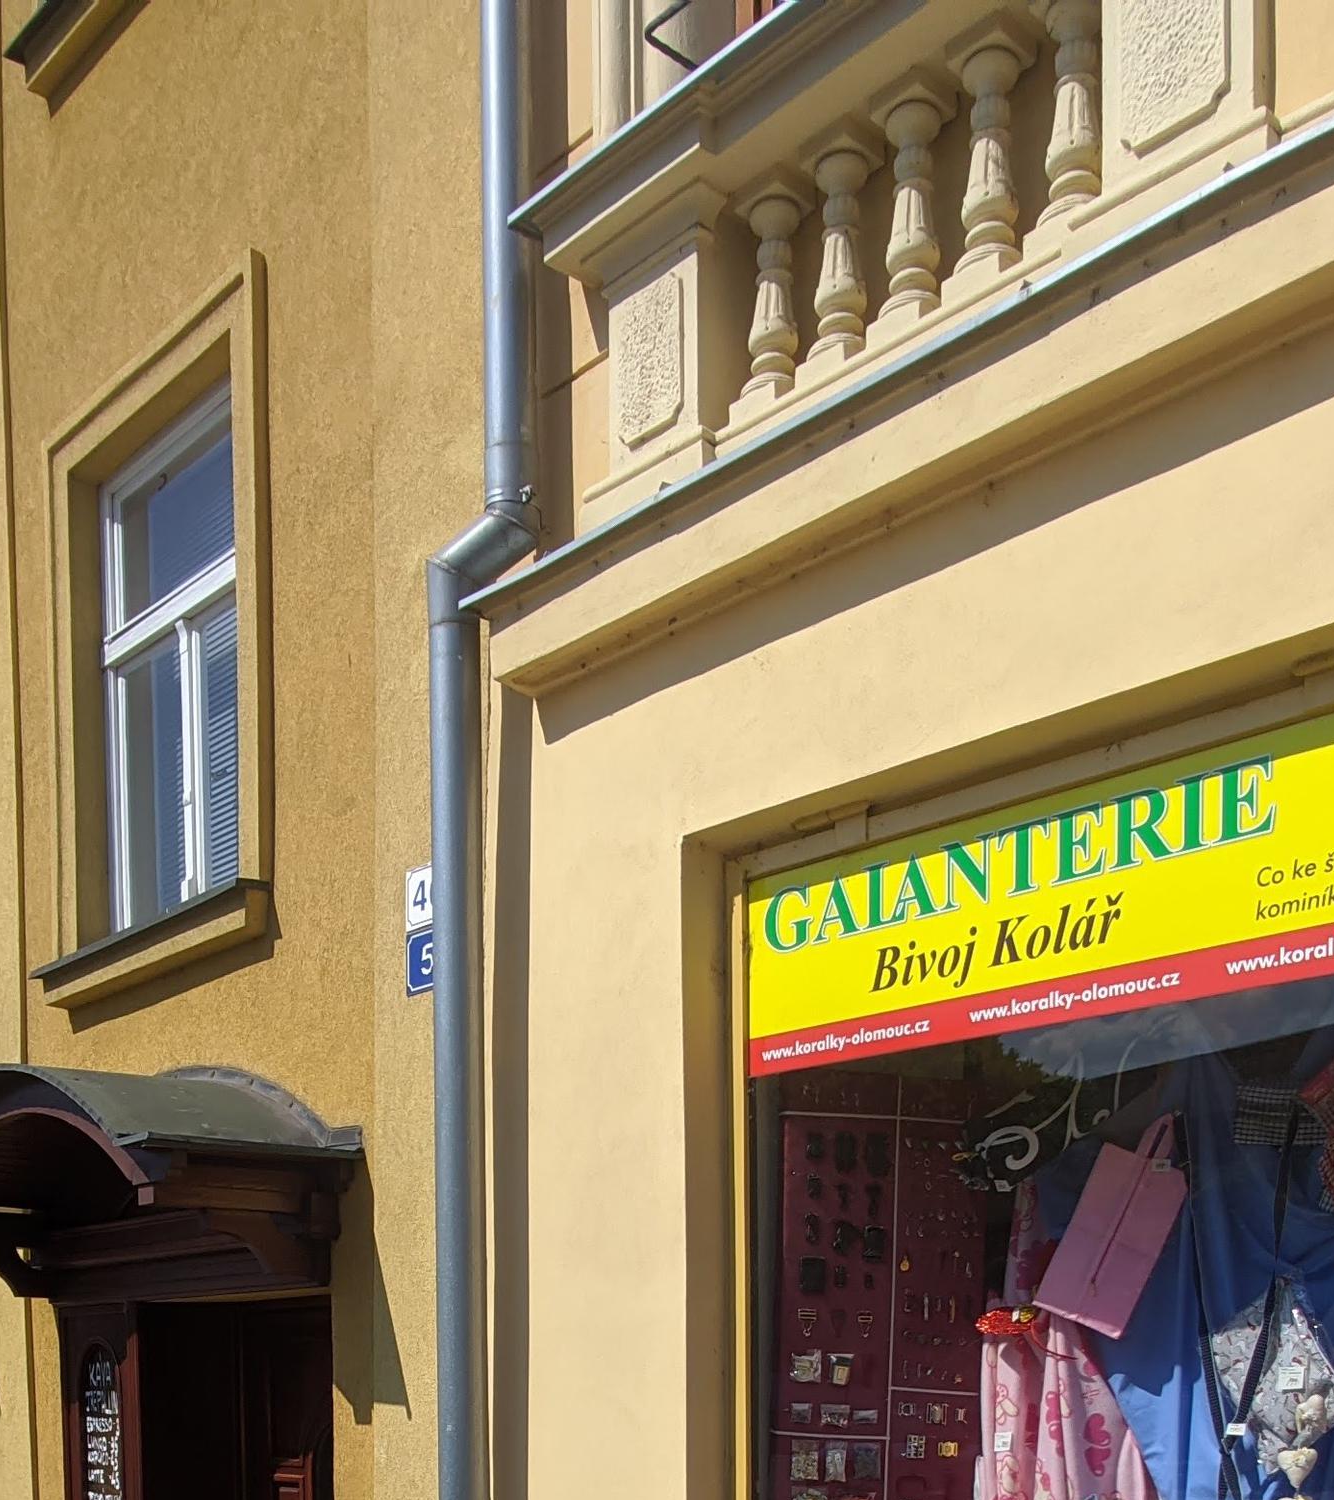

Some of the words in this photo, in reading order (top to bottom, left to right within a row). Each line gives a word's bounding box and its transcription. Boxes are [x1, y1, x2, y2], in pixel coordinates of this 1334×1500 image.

[1256, 866, 1284, 888] Co
[1291, 849, 1317, 881] ke
[868, 926, 977, 993] Bivoj
[987, 891, 1125, 968] Kolář
[969, 972, 1181, 1022] www.koralky-olomouc.cz
[762, 1020, 930, 1061] www.koralky-olomouc.cz
